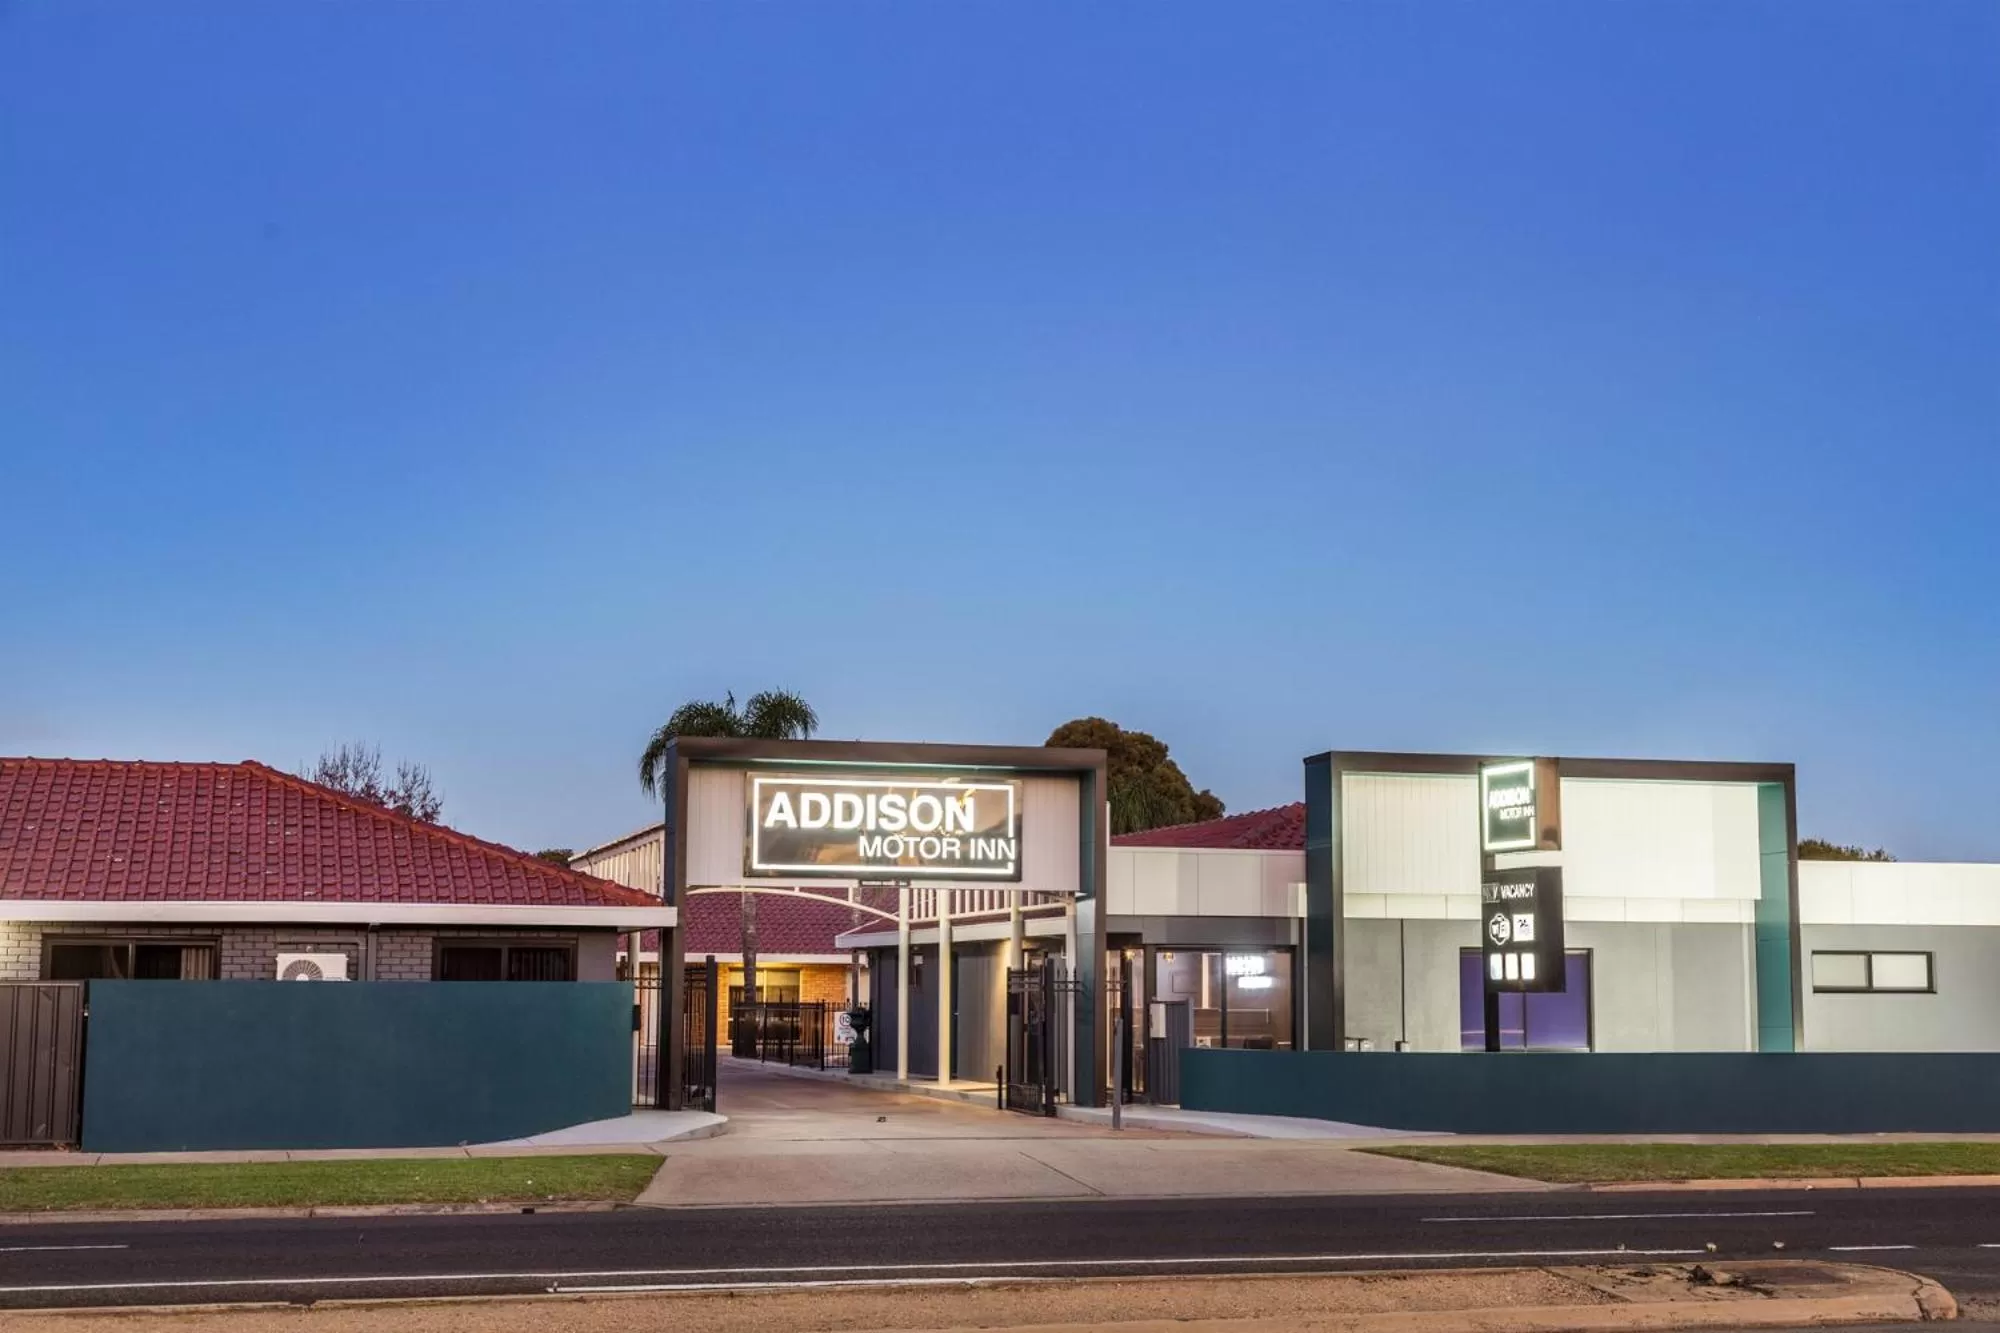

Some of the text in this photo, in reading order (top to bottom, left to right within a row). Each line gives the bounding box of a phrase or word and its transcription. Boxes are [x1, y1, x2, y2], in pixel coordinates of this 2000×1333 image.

[764, 791, 975, 832] ADDISON
[859, 835, 1016, 860] MOTOR INN
[1500, 883, 1534, 899] VACANCY
